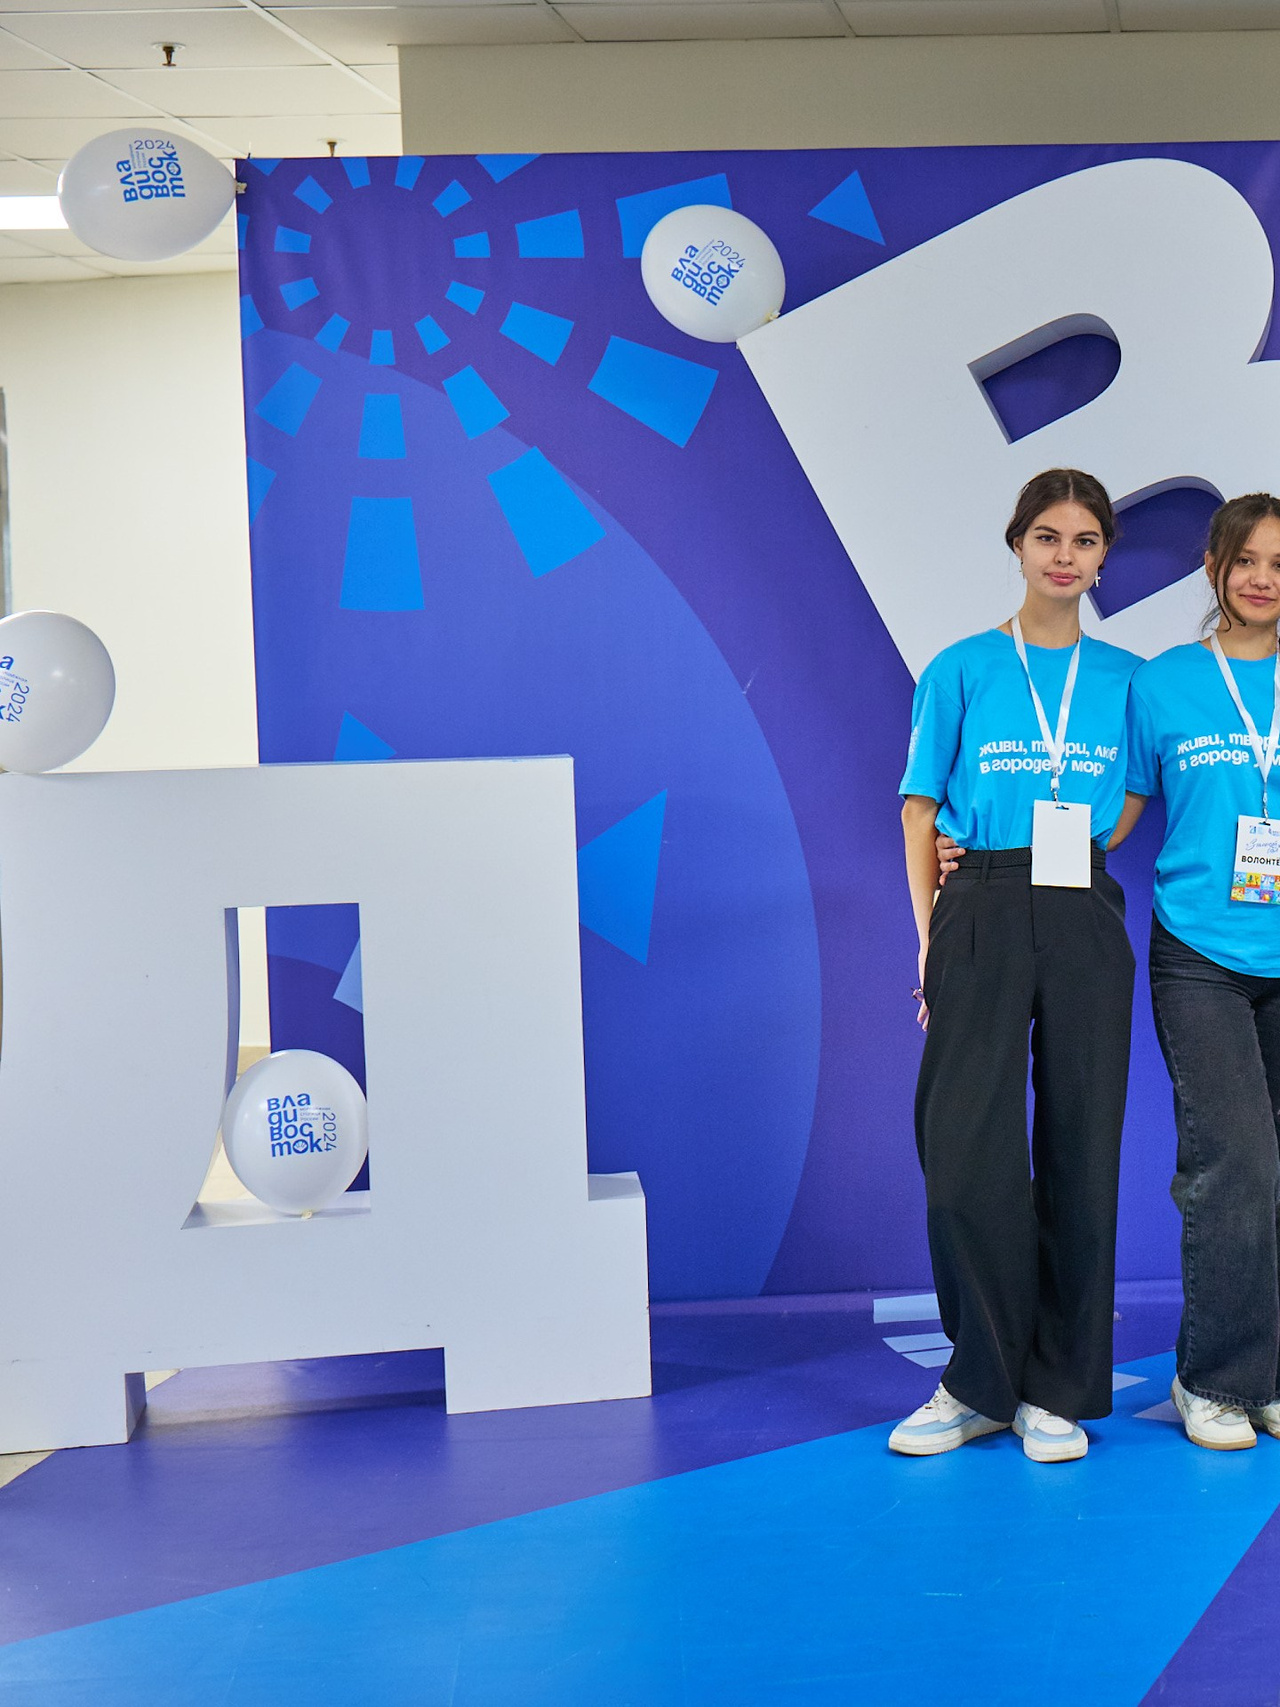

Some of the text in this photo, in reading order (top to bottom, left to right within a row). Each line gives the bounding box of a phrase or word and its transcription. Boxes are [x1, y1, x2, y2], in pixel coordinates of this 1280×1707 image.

[134, 140, 175, 150] 2024
[712, 240, 746, 268] 2024
[6, 682, 30, 722] 2024
[979, 740, 1028, 757] живи,
[1031, 740, 1090, 758] три,
[1177, 733, 1225, 755] живи,
[980, 761, 991, 775] в
[991, 758, 1052, 774] городе
[1179, 760, 1187, 772] в
[1189, 749, 1249, 767] городе
[322, 1112, 337, 1151] 2024
